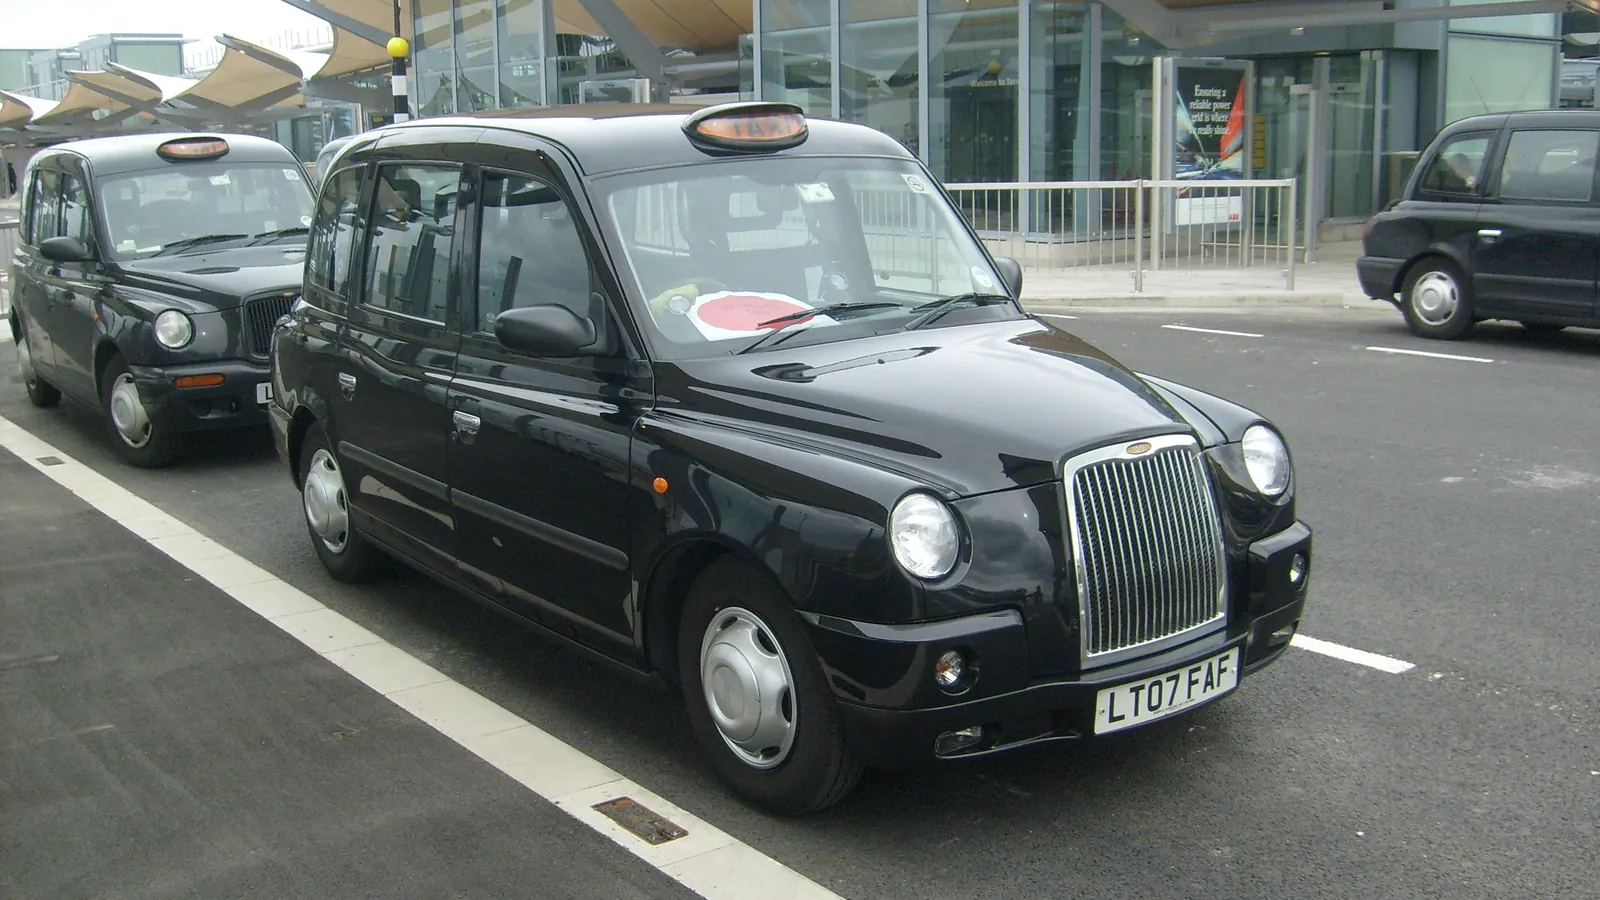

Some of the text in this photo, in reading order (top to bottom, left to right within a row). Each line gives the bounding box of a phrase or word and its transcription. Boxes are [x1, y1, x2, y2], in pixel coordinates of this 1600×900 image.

[1194, 84, 1221, 99] Ensuring
[1189, 99, 1231, 112] reliable power
[1204, 112, 1210, 122] is
[1211, 112, 1229, 122] where
[1197, 124, 1214, 138] really
[1108, 653, 1230, 724] LT07 FAF
